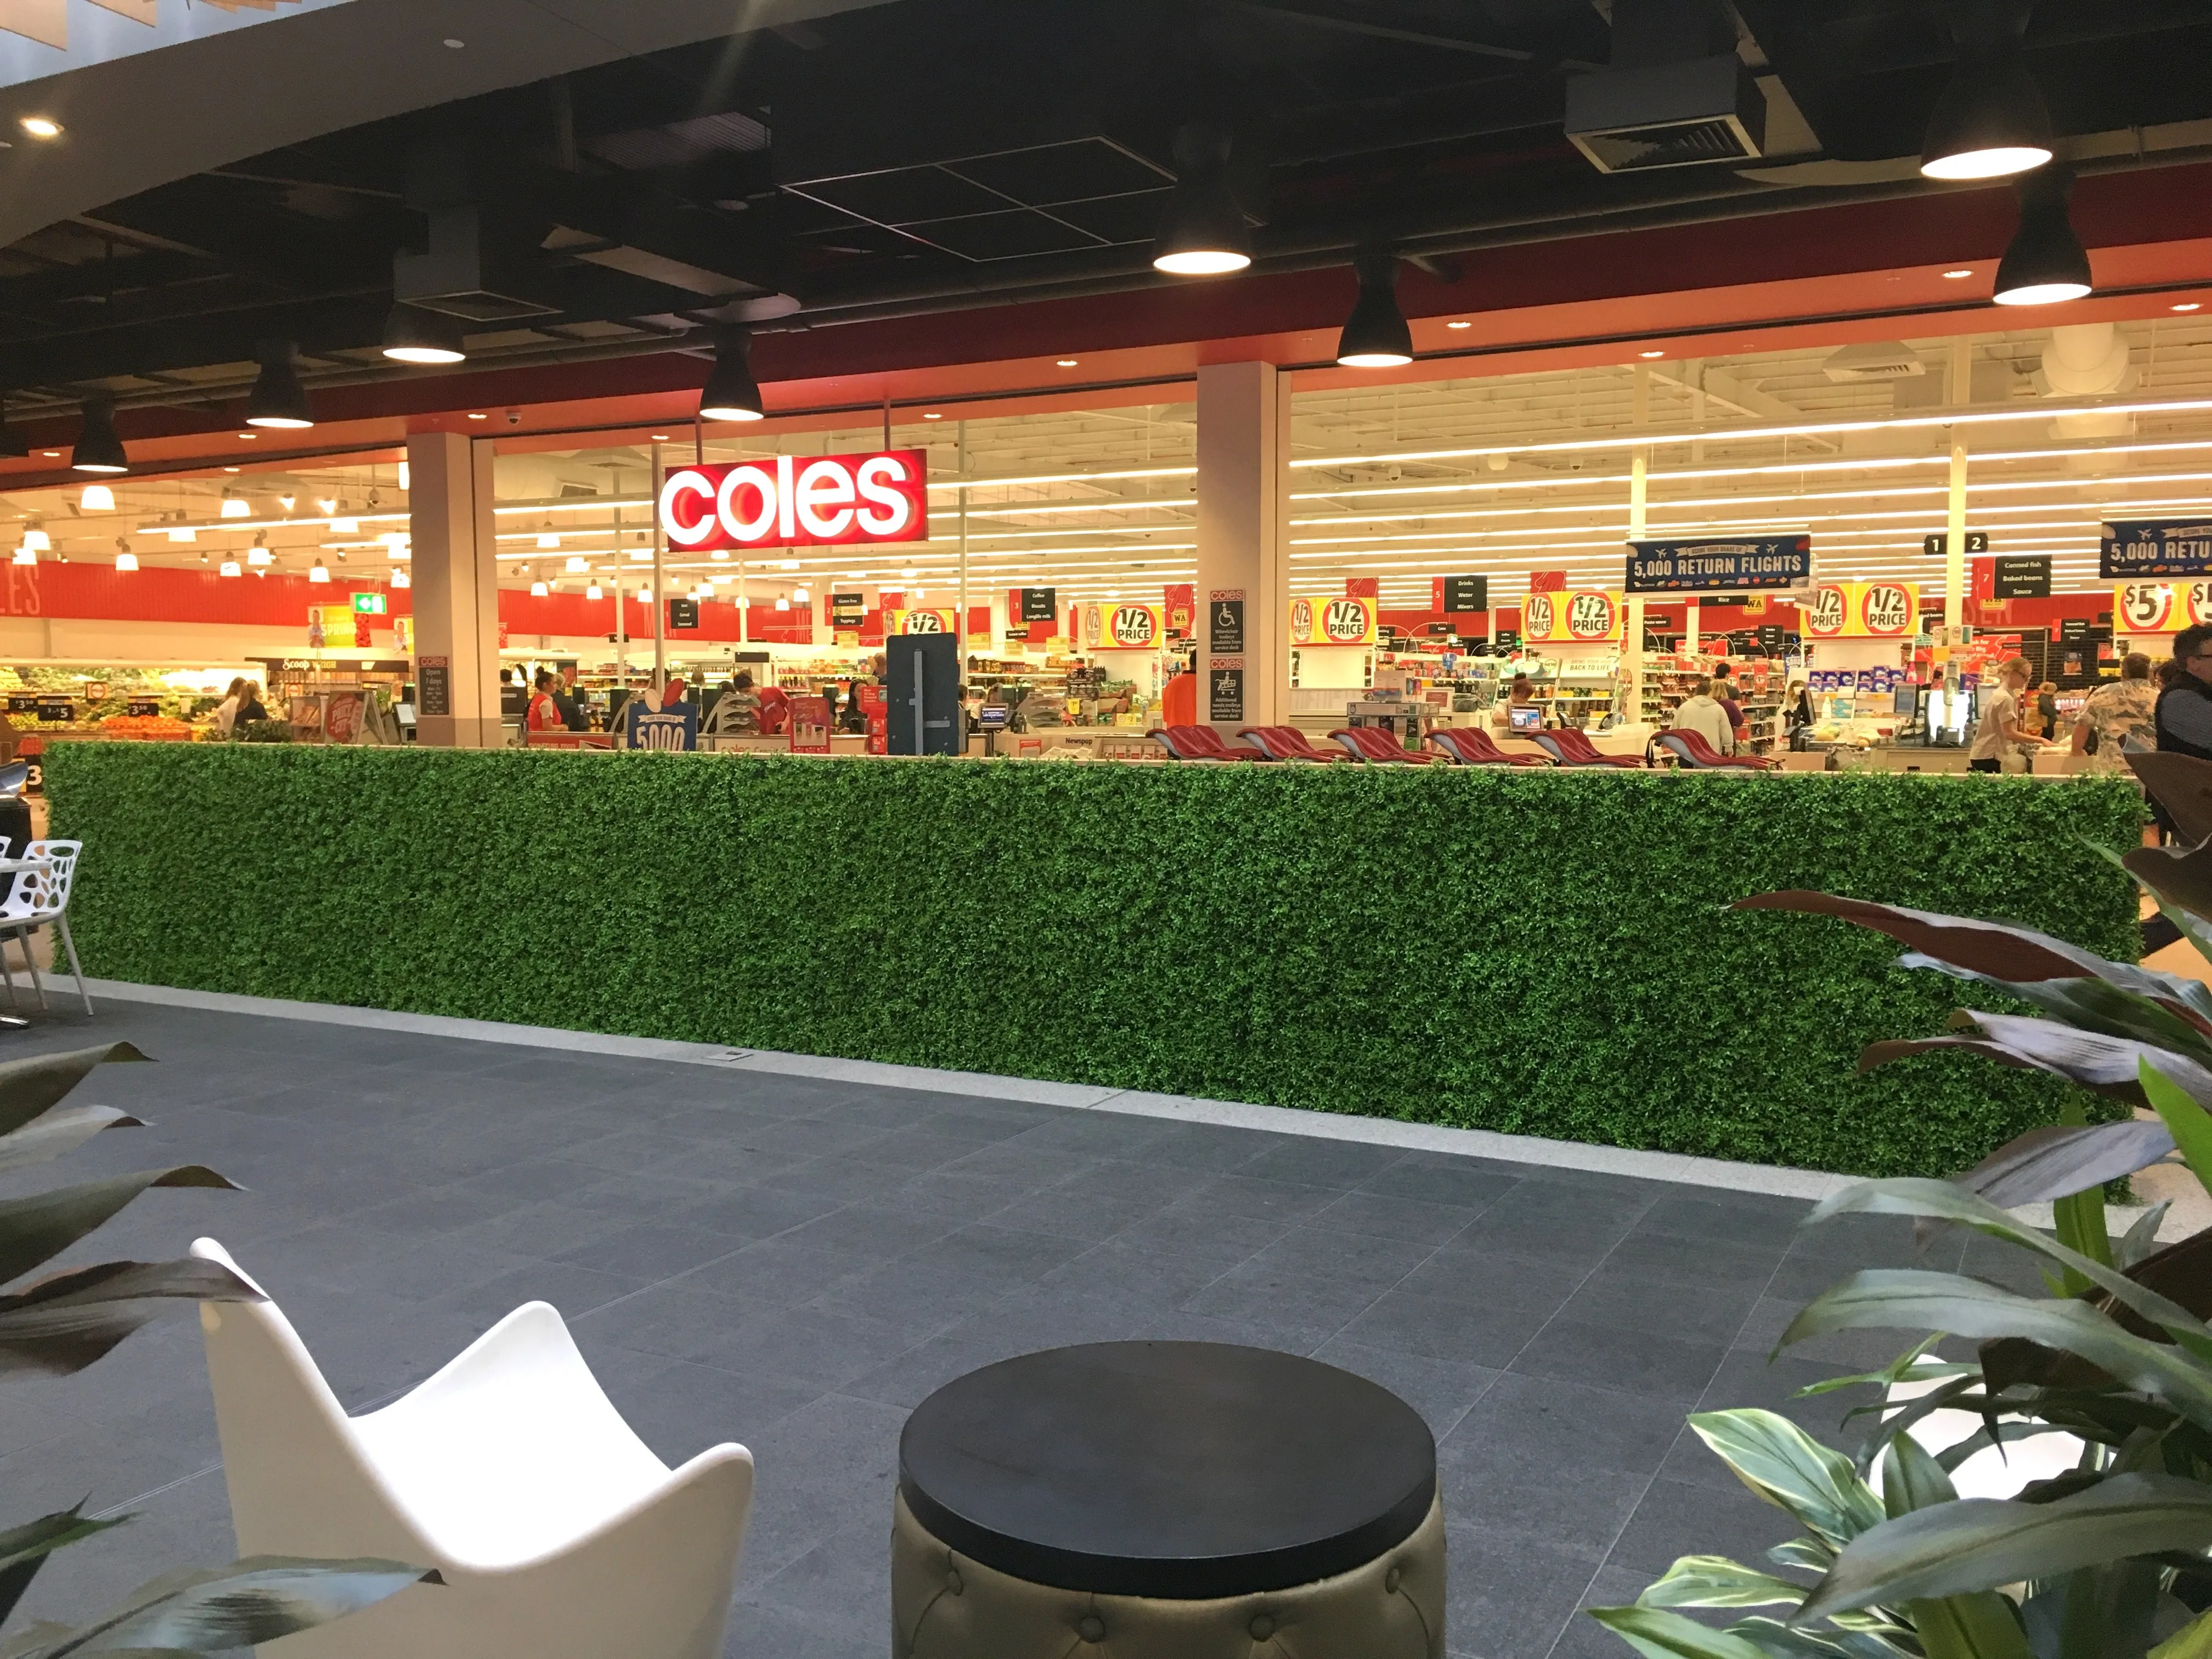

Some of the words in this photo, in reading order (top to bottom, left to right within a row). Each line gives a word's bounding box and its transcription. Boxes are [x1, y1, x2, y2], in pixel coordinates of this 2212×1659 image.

[659, 455, 909, 545] coles
[1932, 539, 1939, 551] 1
[1972, 537, 1981, 550] 2
[2111, 541, 2158, 563] 5,000
[1634, 560, 1672, 579] 5,000
[1678, 557, 1735, 575] RETURN
[1741, 555, 1802, 573] FLIGHTS
[1983, 574, 1989, 583] 7
[1211, 590, 1243, 600] coles
[1872, 588, 1904, 612] 1/2
[1530, 597, 1549, 620] 1/2
[1575, 596, 1606, 619] 1/2
[1748, 599, 1762, 608] WA
[2125, 584, 2157, 620] $5
[1119, 608, 1148, 629] 1/2
[1295, 603, 1309, 624] 1/2
[1331, 601, 1362, 623] 1/2
[908, 613, 939, 633] 1/2
[1573, 619, 1609, 631] PRICE
[1811, 614, 1842, 627] PRICE
[1870, 613, 1906, 625] PRICE
[321, 622, 357, 637] SPRING
[1294, 624, 1310, 635] PRICE
[1329, 624, 1364, 635] PRICE
[1528, 620, 1550, 632] PRICE
[1117, 629, 1150, 639] PRICE
[283, 658, 311, 671] Scoop
[1211, 658, 1243, 669] coles
[426, 668, 441, 677] Open
